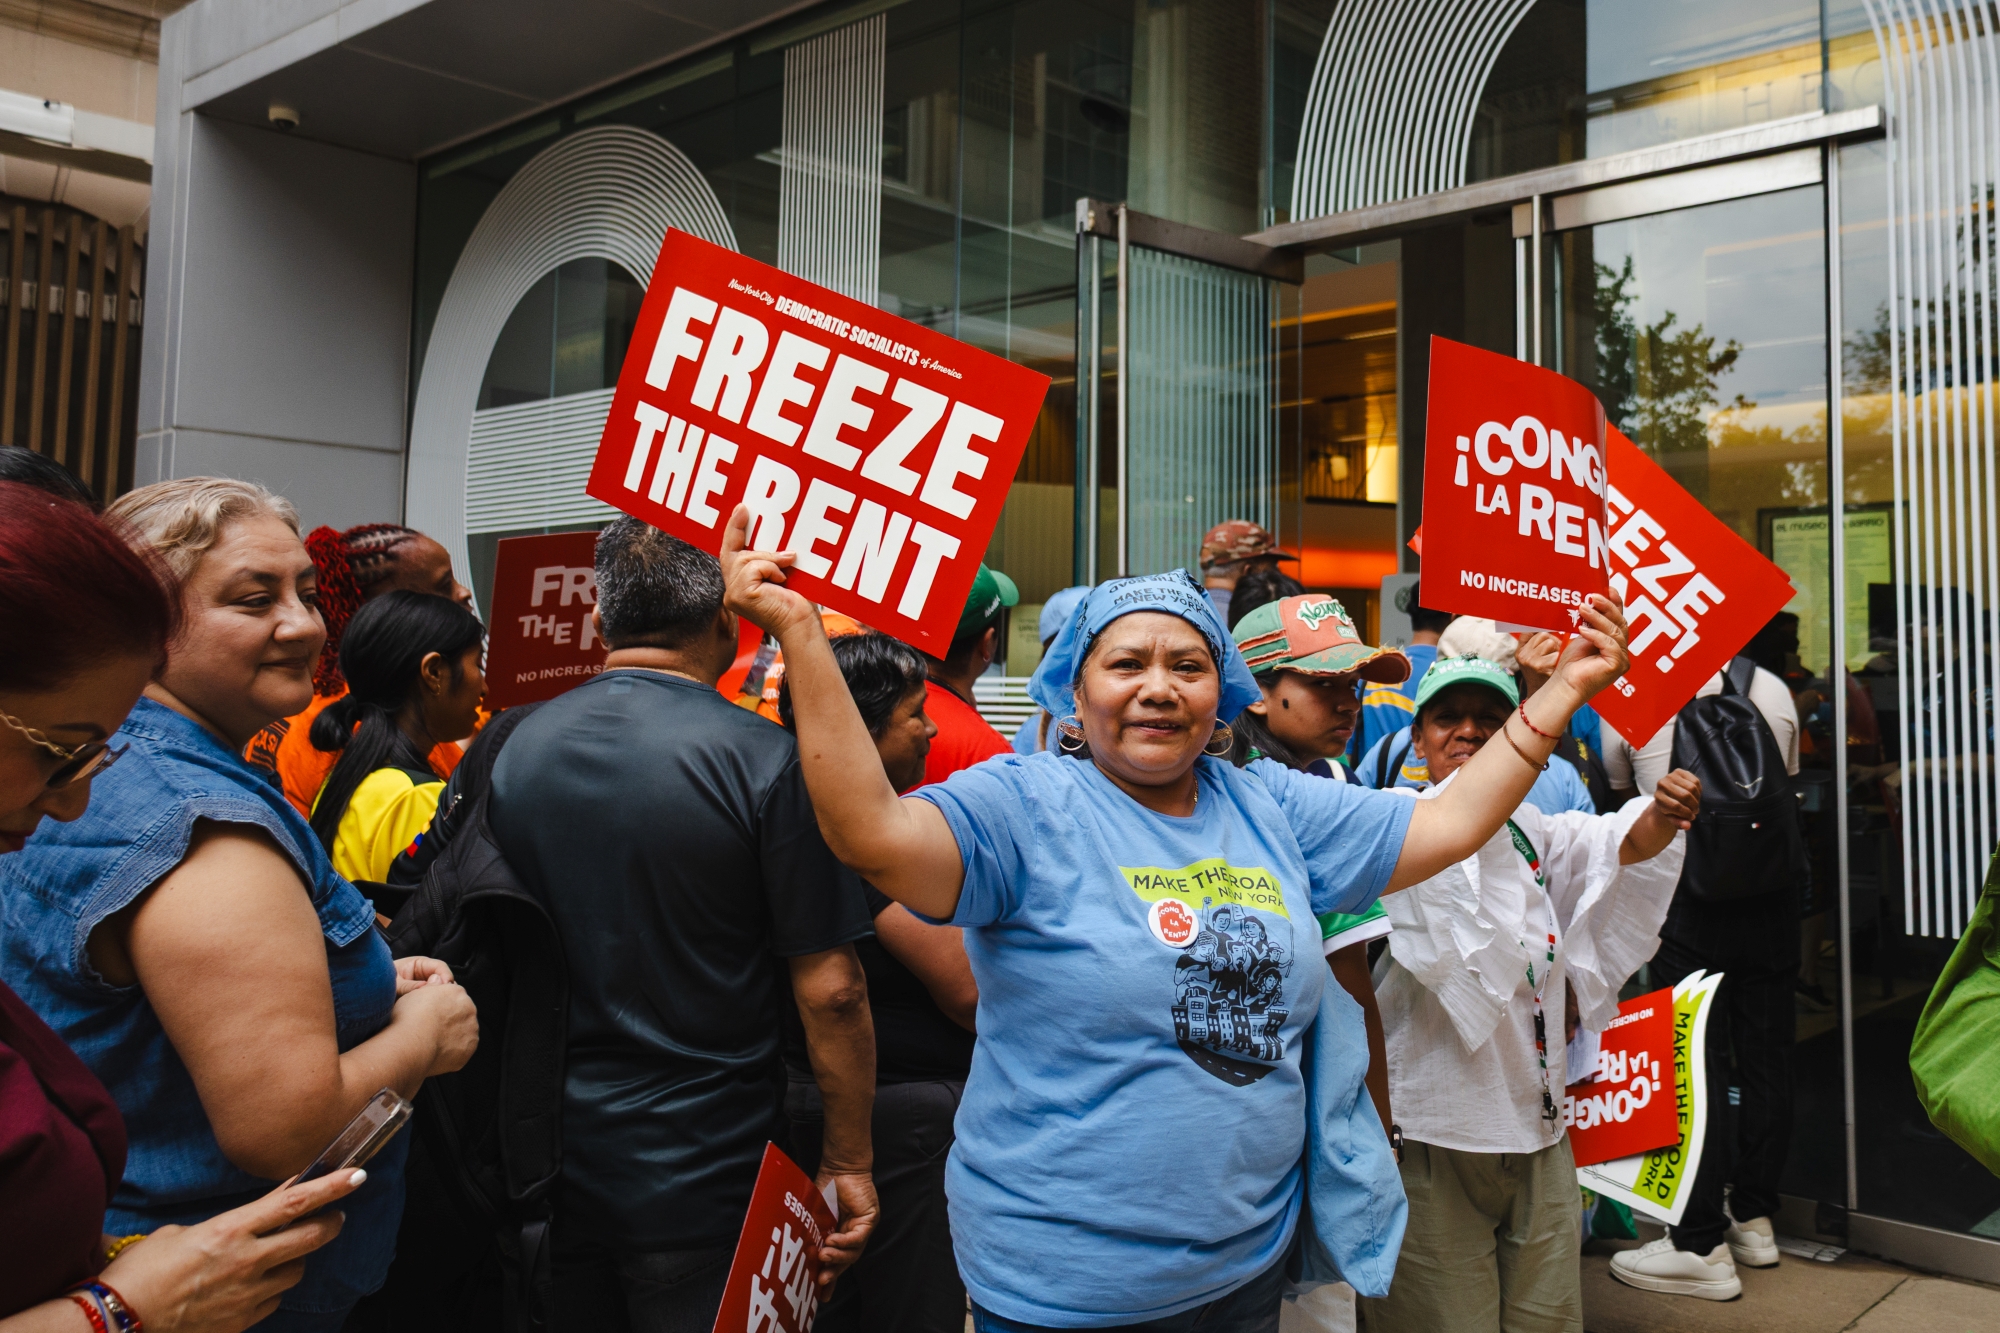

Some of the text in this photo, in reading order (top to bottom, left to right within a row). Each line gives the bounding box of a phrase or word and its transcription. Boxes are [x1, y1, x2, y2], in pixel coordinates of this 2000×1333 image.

[775, 295, 851, 338] DEMOCRATIC
[849, 325, 920, 366] SOCIALISTS
[920, 357, 931, 370] of
[929, 360, 963, 380] America
[644, 286, 1005, 521] FREEZE
[623, 400, 962, 622] THE RENT
[1475, 483, 1511, 516] LA
[530, 565, 598, 608] FR
[1113, 587, 1155, 606] MAKE
[1132, 594, 1167, 604] NEW
[1460, 570, 1486, 590] NO
[1487, 575, 1582, 607] INCREASES
[518, 614, 574, 646] THE
[516, 670, 538, 684] NO
[1612, 675, 1636, 698] ES
[1133, 873, 1191, 894] MAKE
[1191, 866, 1228, 890] THE
[1163, 927, 1189, 939] RENTA!
[1169, 918, 1180, 927] LA
[1603, 1007, 1655, 1032] NO INCREA
[1672, 1012, 1691, 1076] MAKE
[1628, 1050, 1649, 1074] LA
[1675, 1078, 1689, 1126] THE
[1641, 1147, 1665, 1193] ORK
[783, 1190, 815, 1234] LEASES
